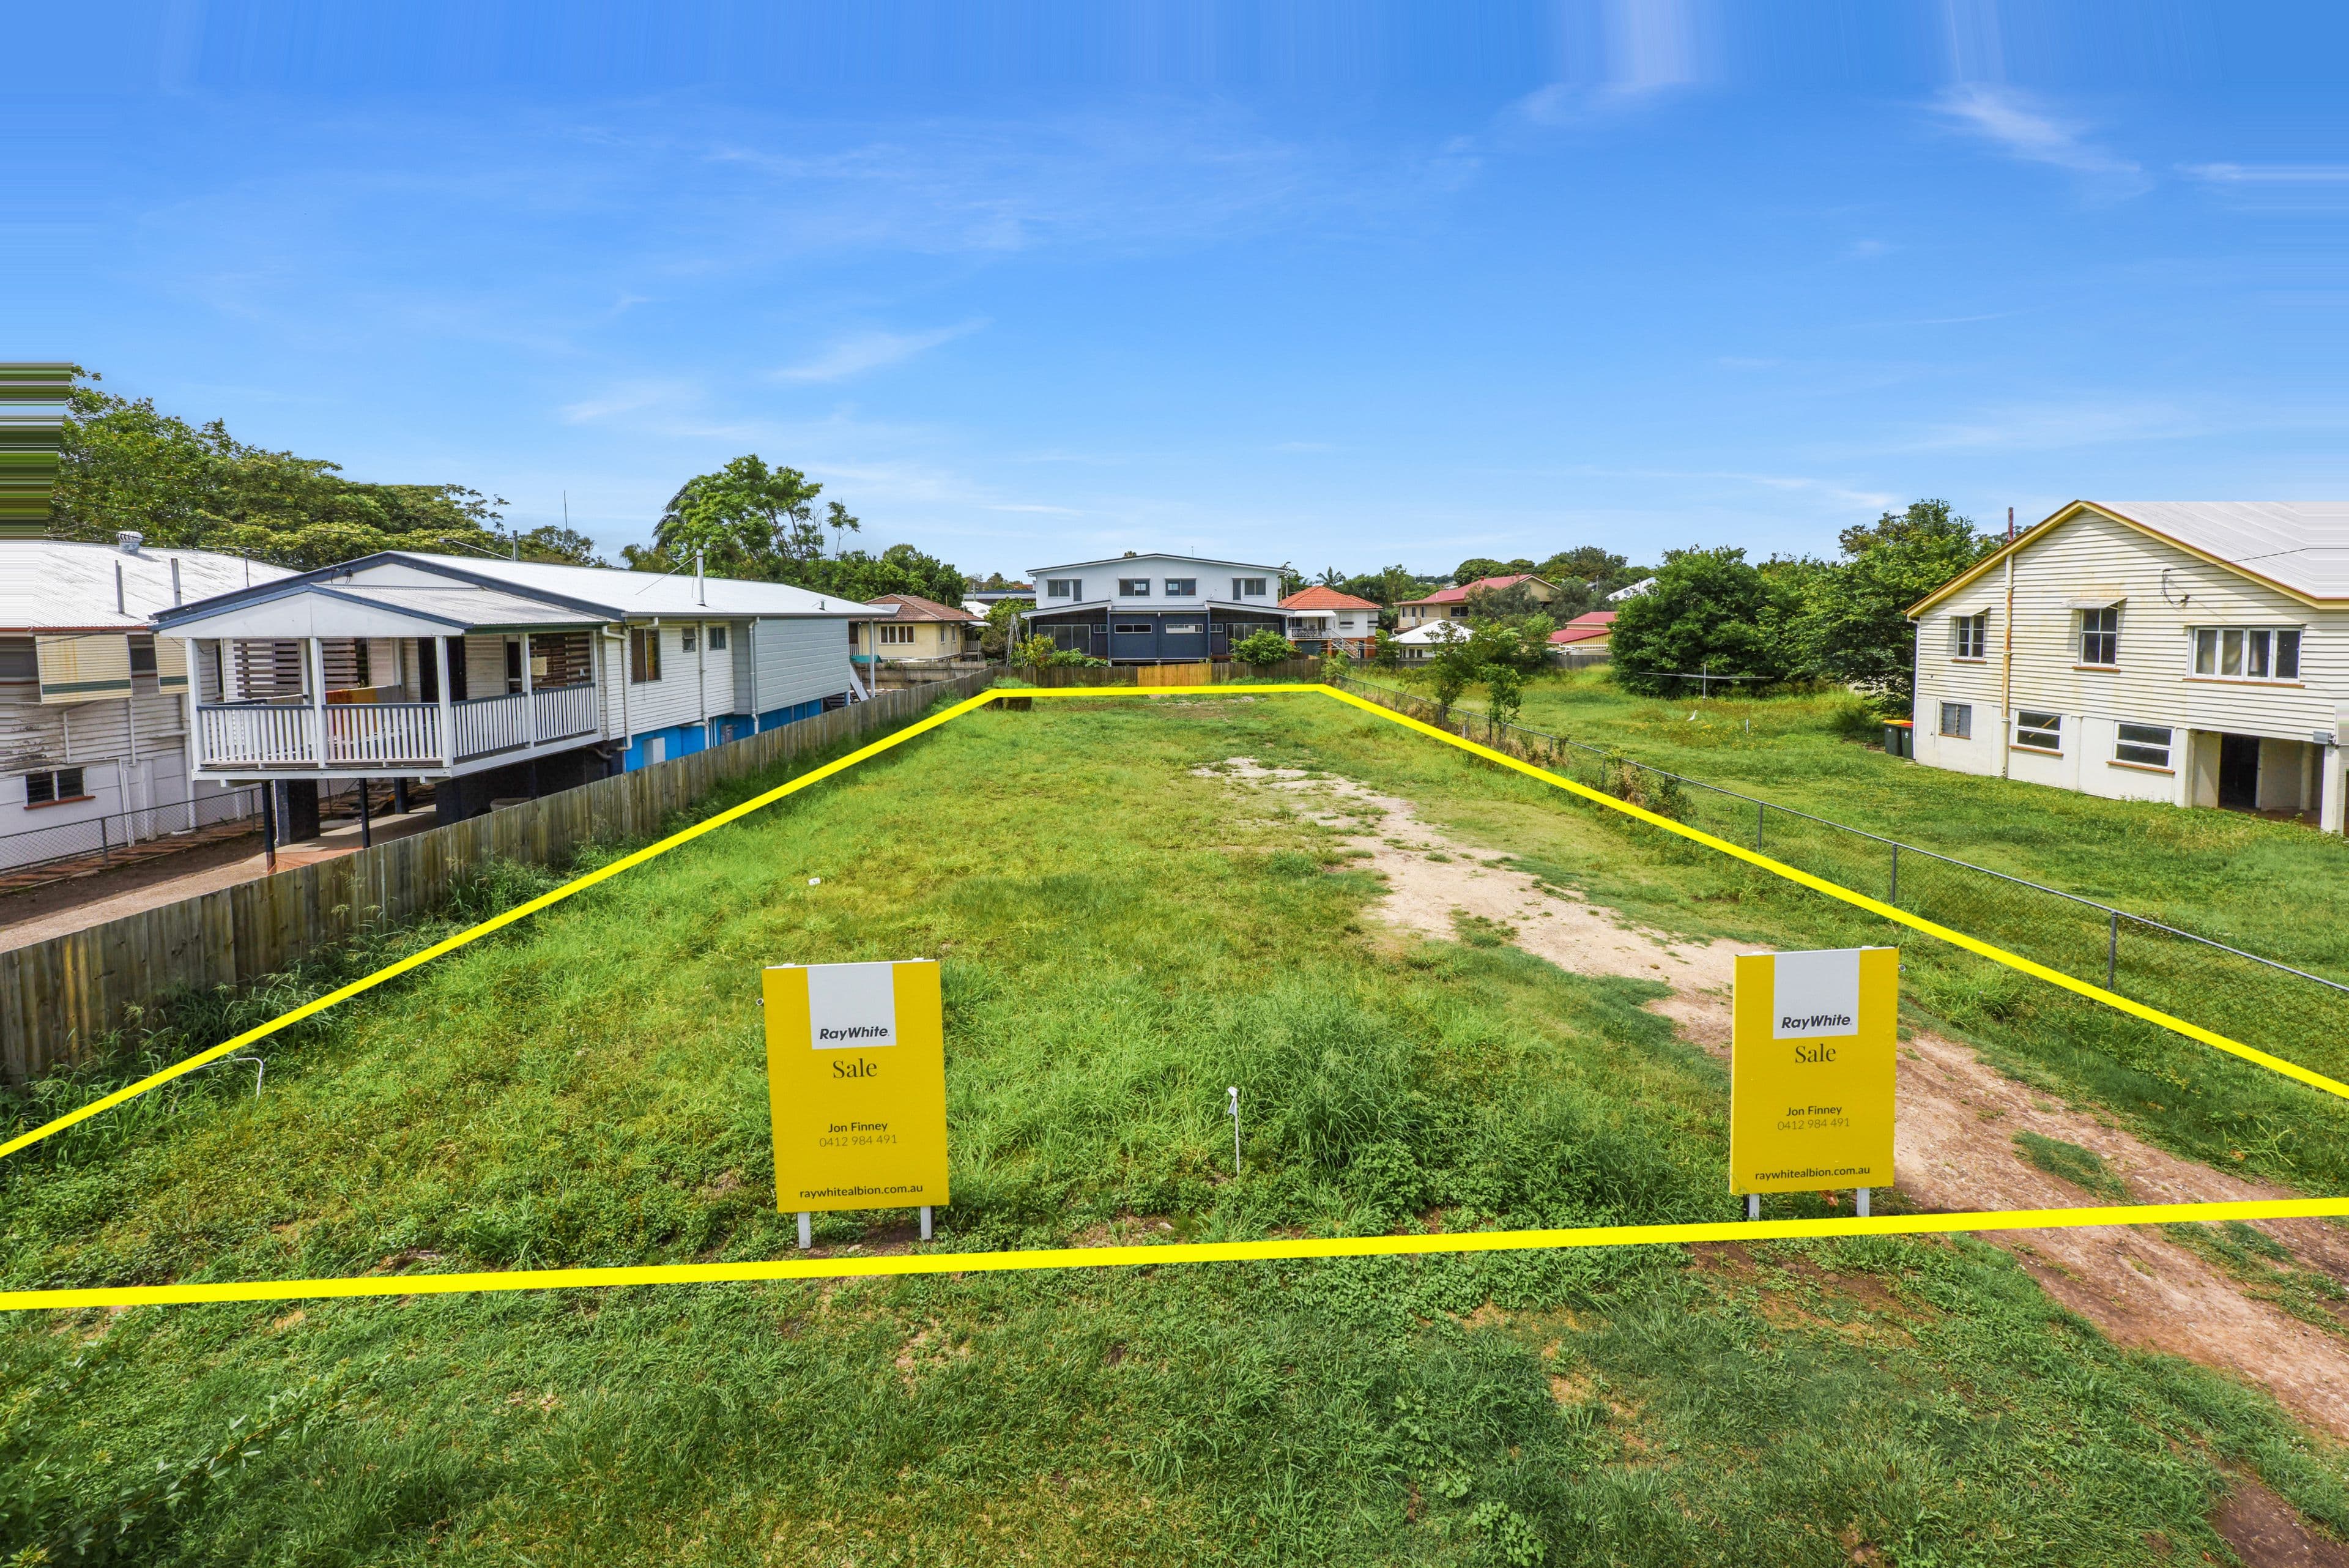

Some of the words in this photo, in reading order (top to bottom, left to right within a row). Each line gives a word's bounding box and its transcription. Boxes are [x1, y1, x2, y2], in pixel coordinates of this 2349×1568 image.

[1795, 1043, 1836, 1063] Sale
[833, 1058, 877, 1079] Sale
[1786, 1106, 1805, 1117] Jon
[1808, 1105, 1842, 1116] Finney
[828, 1123, 847, 1133] Jon
[851, 1121, 888, 1133] Finney
[1778, 1120, 1804, 1130] 0412
[1808, 1119, 1827, 1129] 984
[1830, 1118, 1850, 1128] 491
[819, 1136, 848, 1147] 0412
[852, 1135, 873, 1146] 984
[877, 1134, 897, 1145] 491
[1755, 1165, 1870, 1181] raywhitealbion.com.au
[800, 1183, 923, 1198] raywhitealbion.com.au
